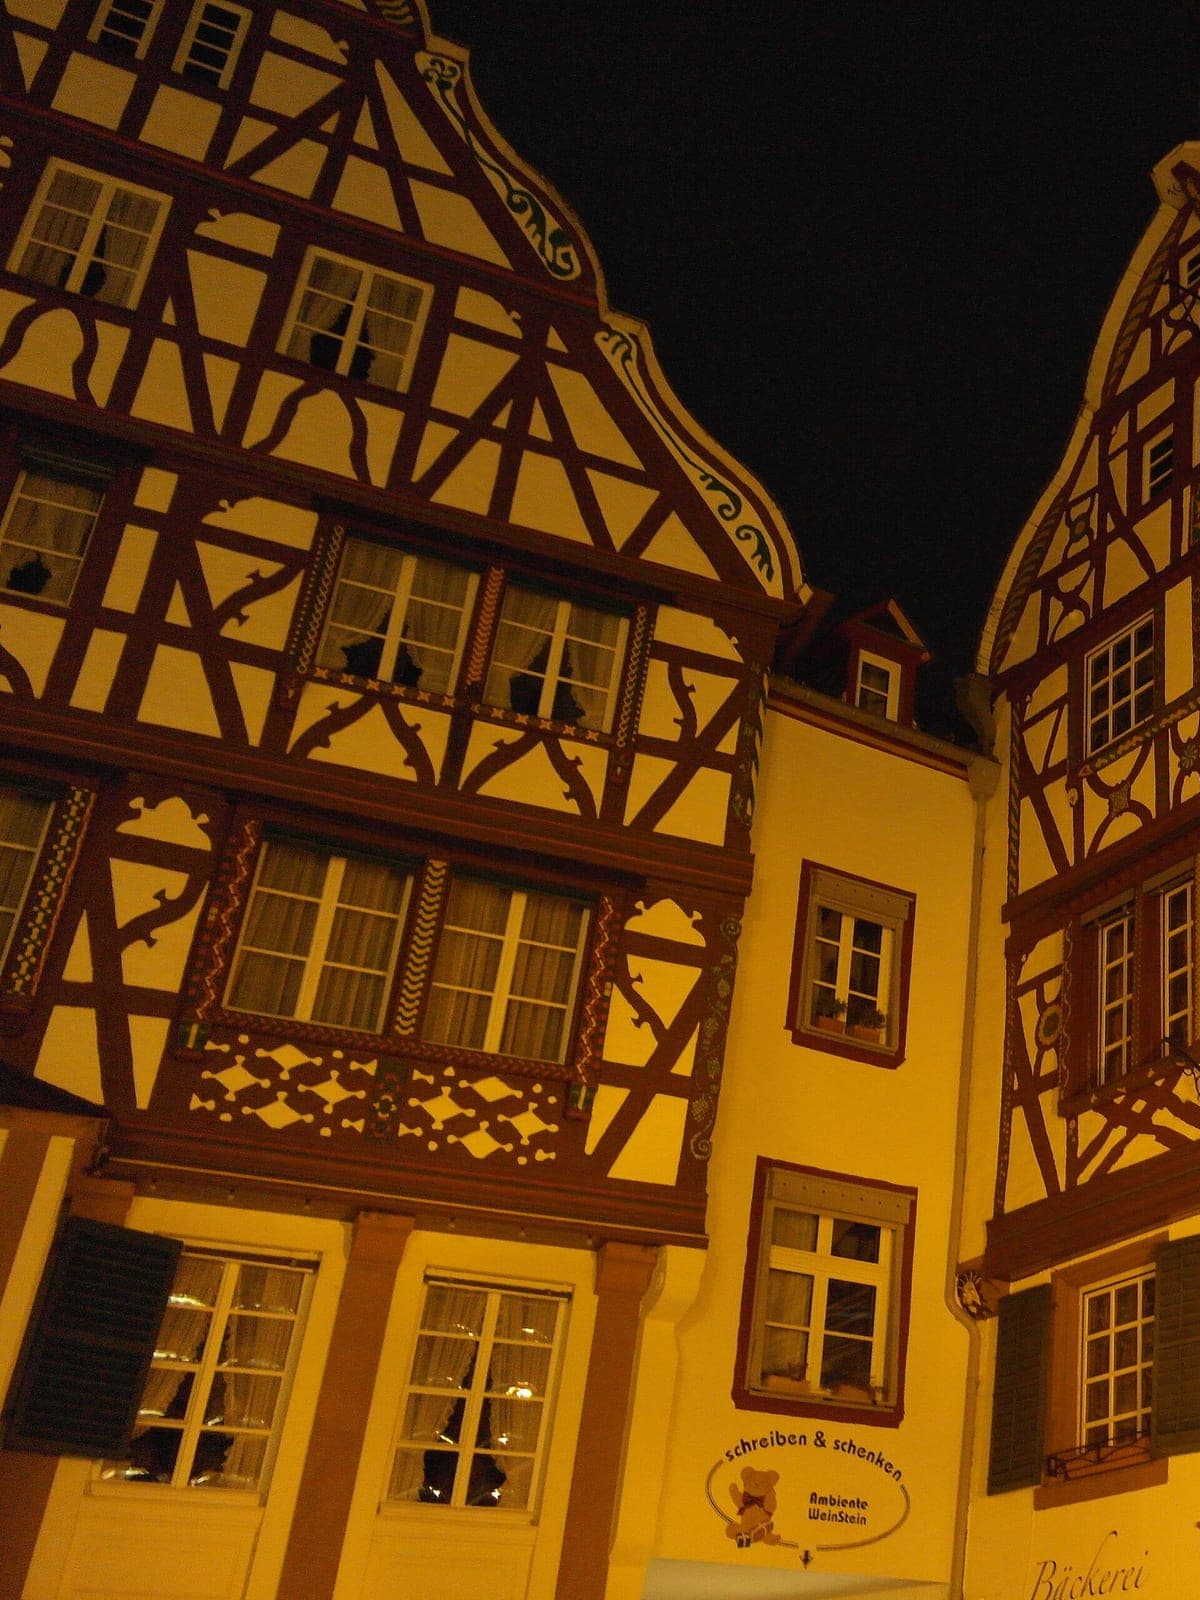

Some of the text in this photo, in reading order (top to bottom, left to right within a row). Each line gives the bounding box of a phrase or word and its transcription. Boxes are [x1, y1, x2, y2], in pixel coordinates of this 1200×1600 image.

[725, 1430, 903, 1482] schreiben & schenken
[808, 1508, 868, 1526] WeinStein
[809, 1492, 868, 1511] Ambiente
[1031, 1530, 1149, 1600] Bäckerei
